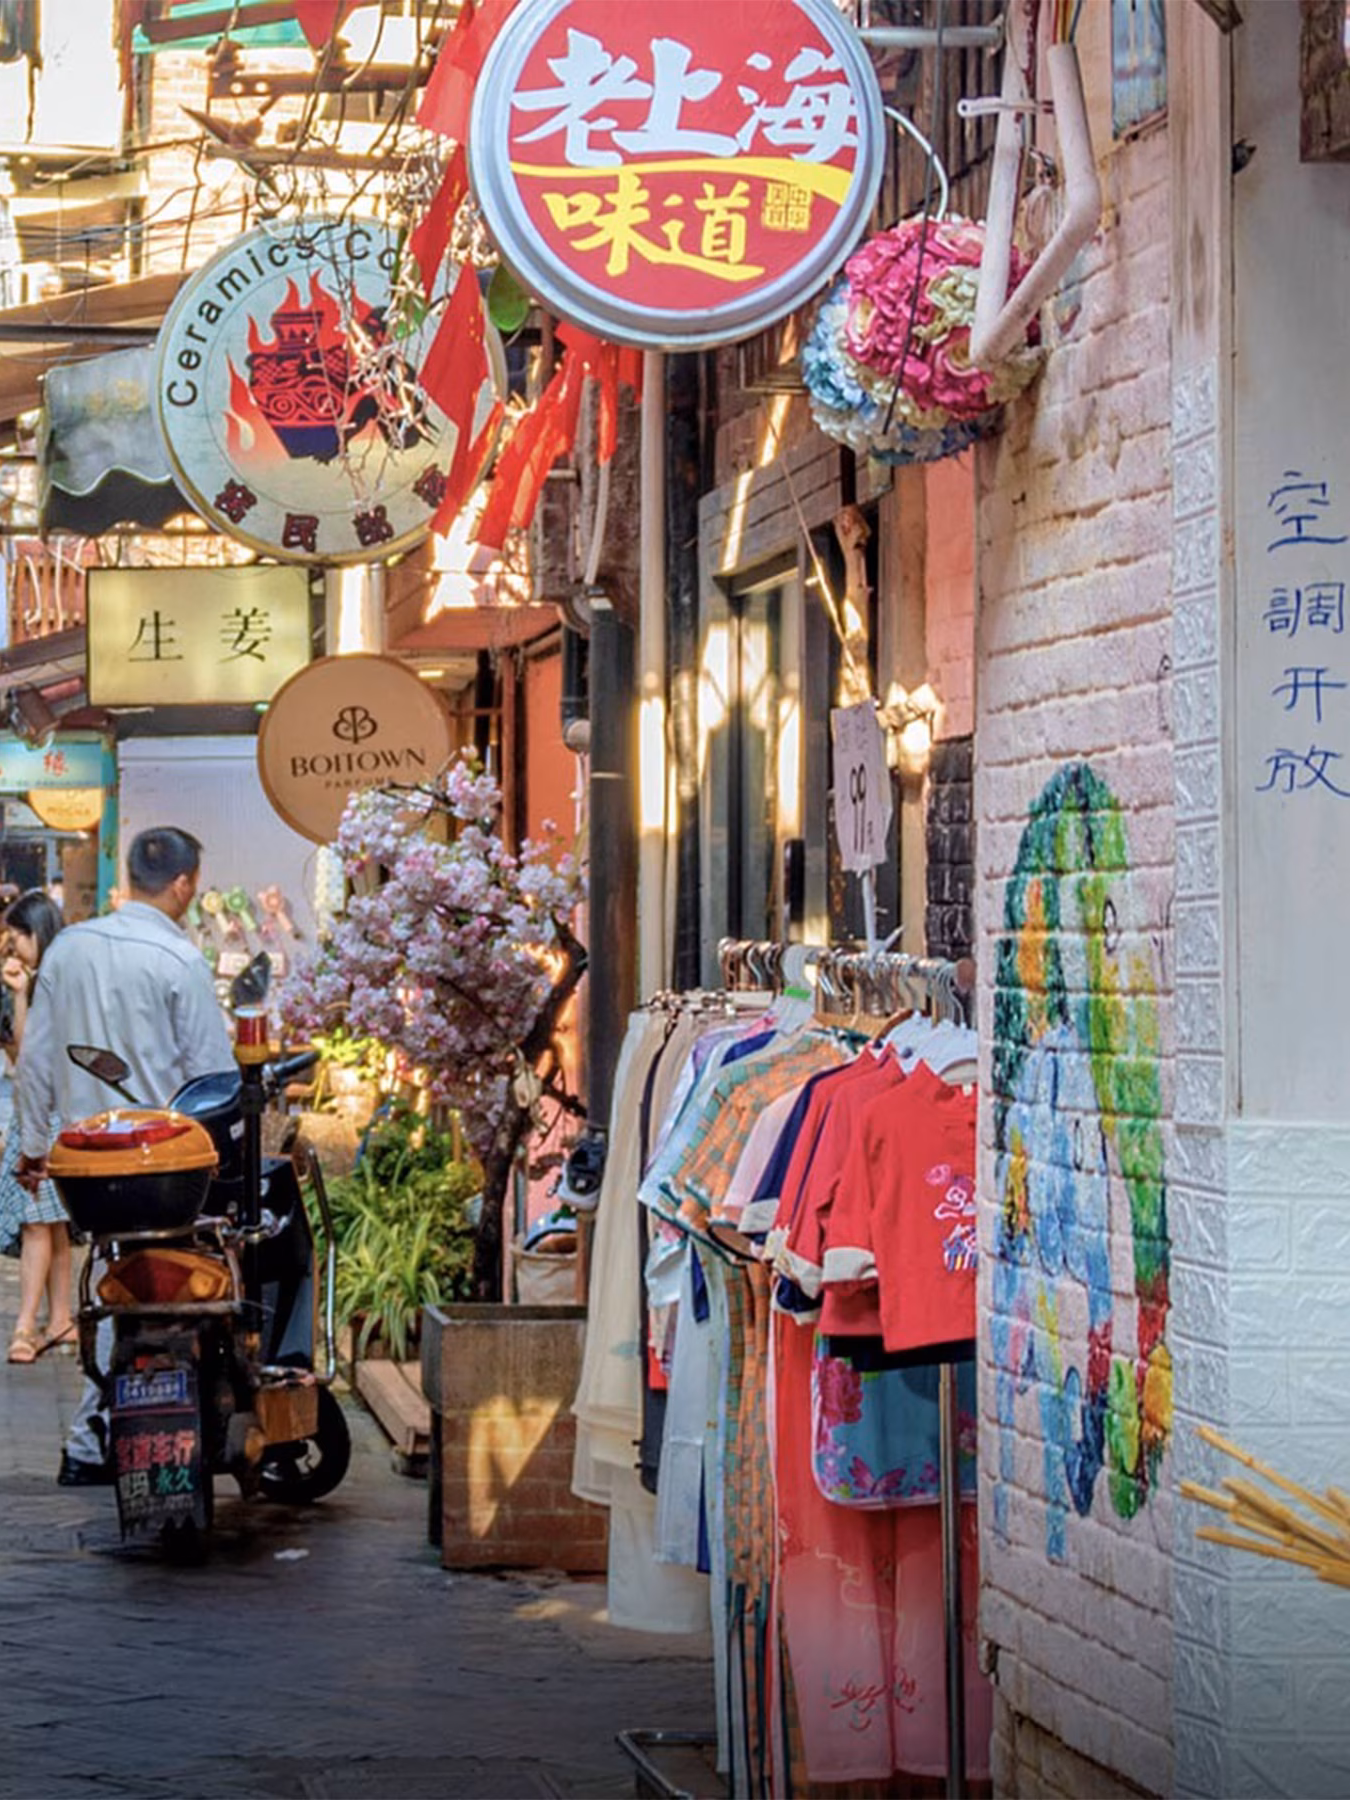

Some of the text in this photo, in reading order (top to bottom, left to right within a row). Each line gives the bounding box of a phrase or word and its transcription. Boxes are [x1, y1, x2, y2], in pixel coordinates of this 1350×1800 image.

[513, 28, 858, 167] 老上海
[542, 174, 765, 282] 味道
[166, 238, 316, 407] Ceramics
[127, 606, 273, 664] 生姜
[290, 748, 427, 778] BOITOWN
